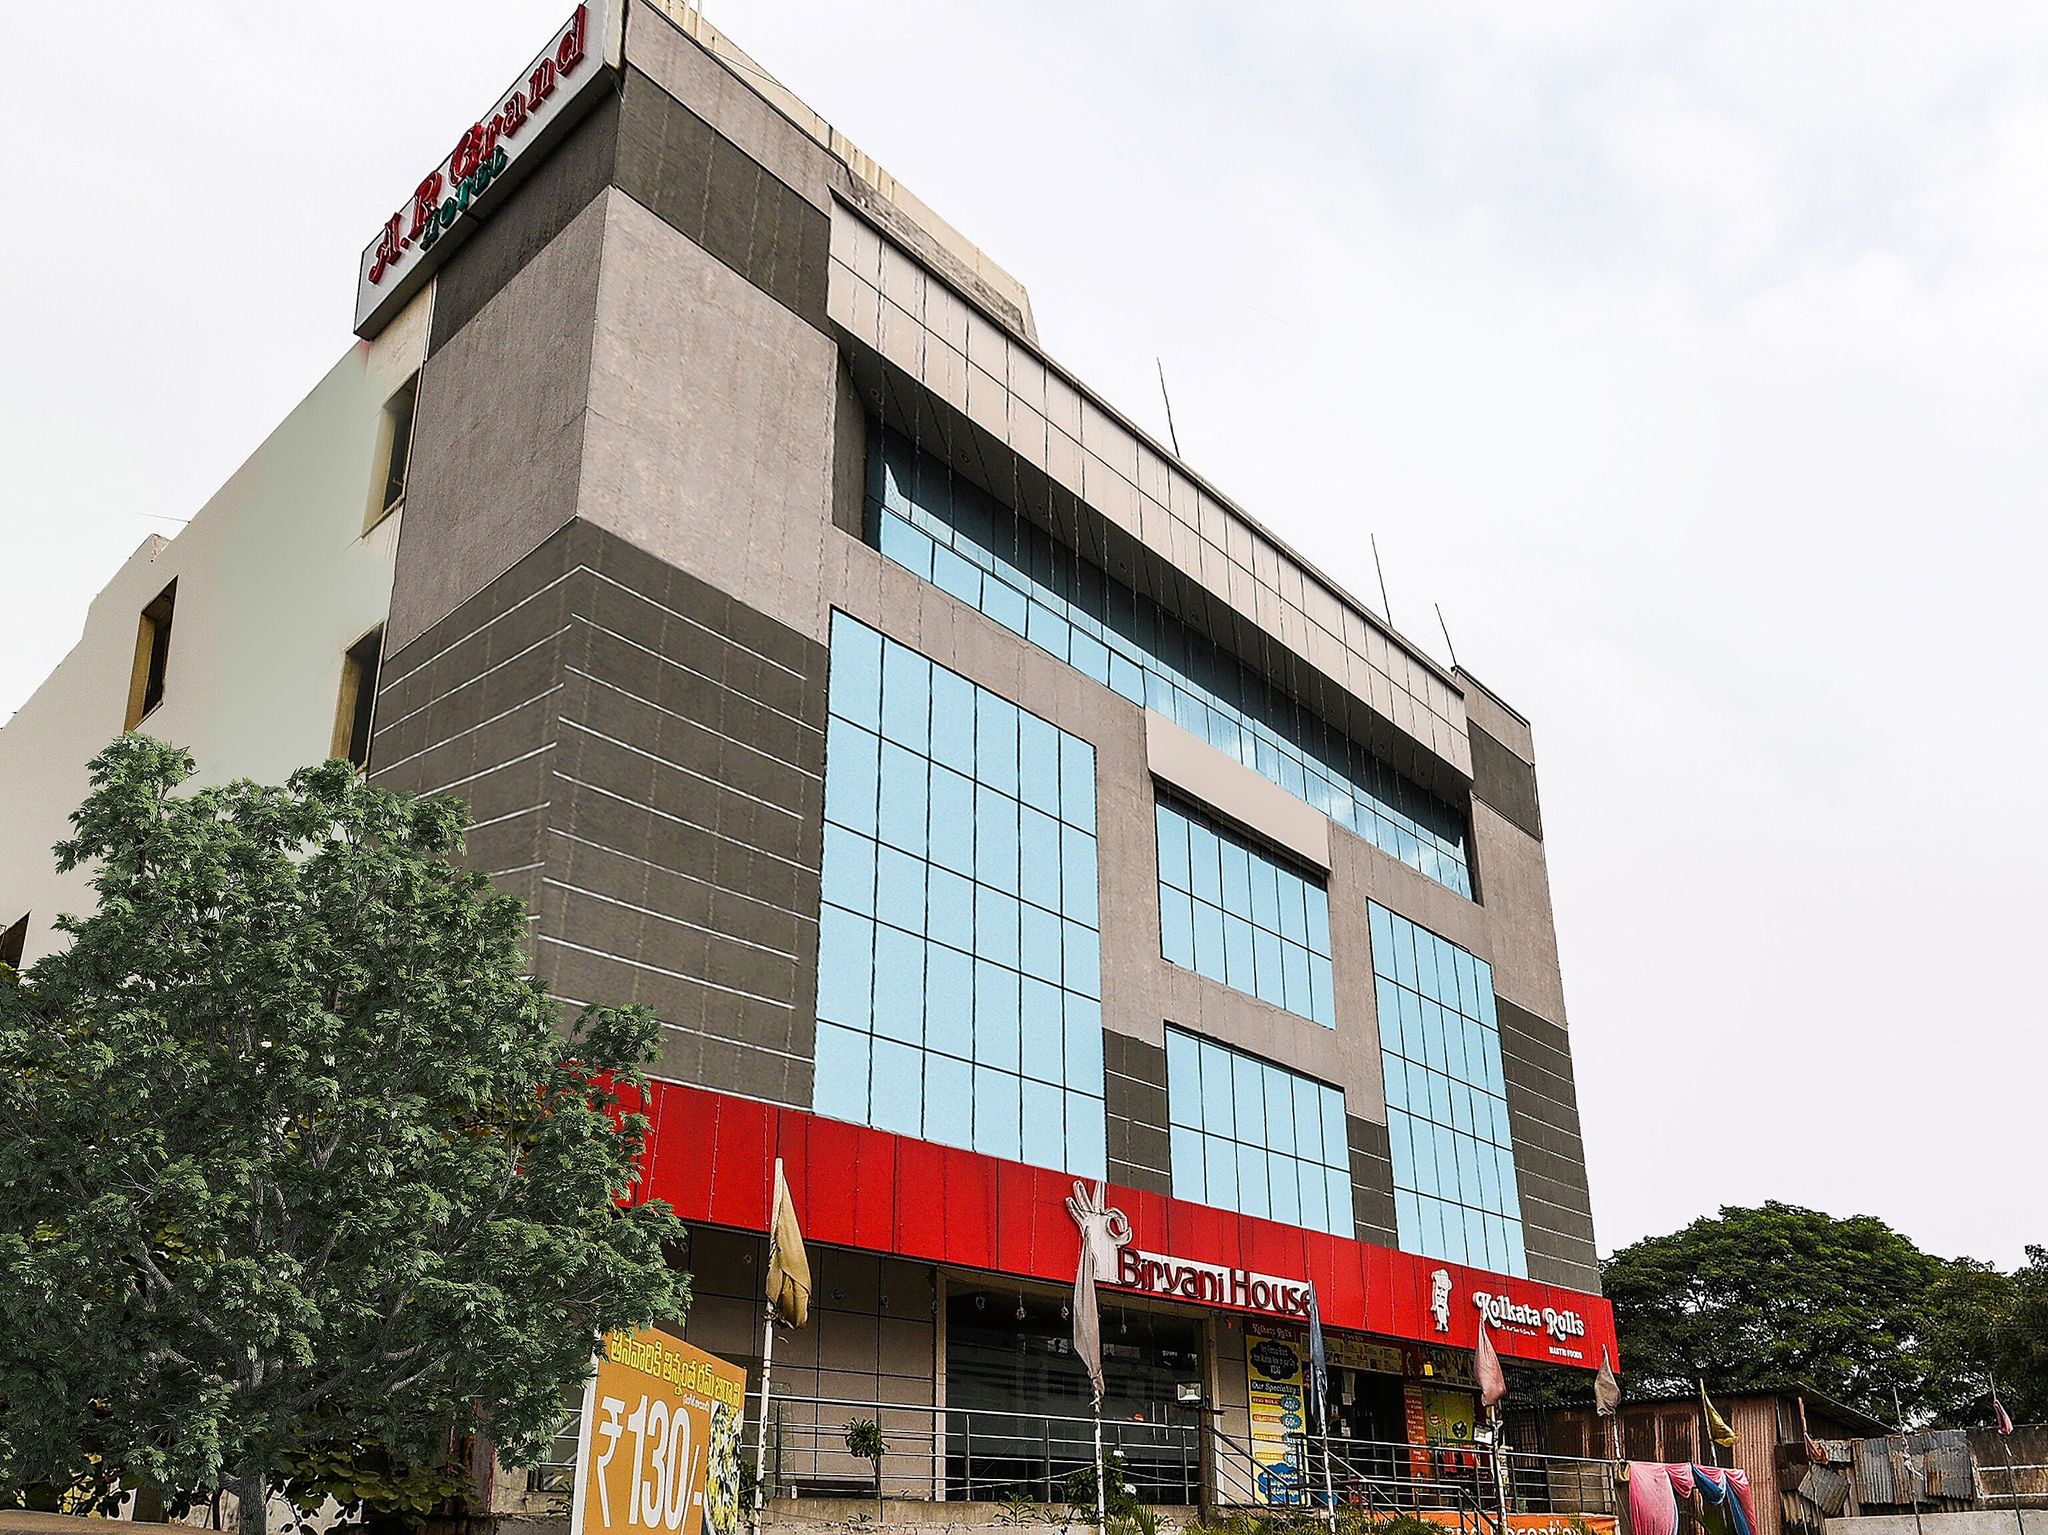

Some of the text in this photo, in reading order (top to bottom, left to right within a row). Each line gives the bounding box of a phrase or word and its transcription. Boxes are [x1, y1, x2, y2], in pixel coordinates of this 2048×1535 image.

[449, 3, 587, 188] Grand
[1117, 1247, 1311, 1316] Biryani House
[1473, 1291, 1541, 1328] Kolkata
[1252, 1381, 1264, 1390] Our
